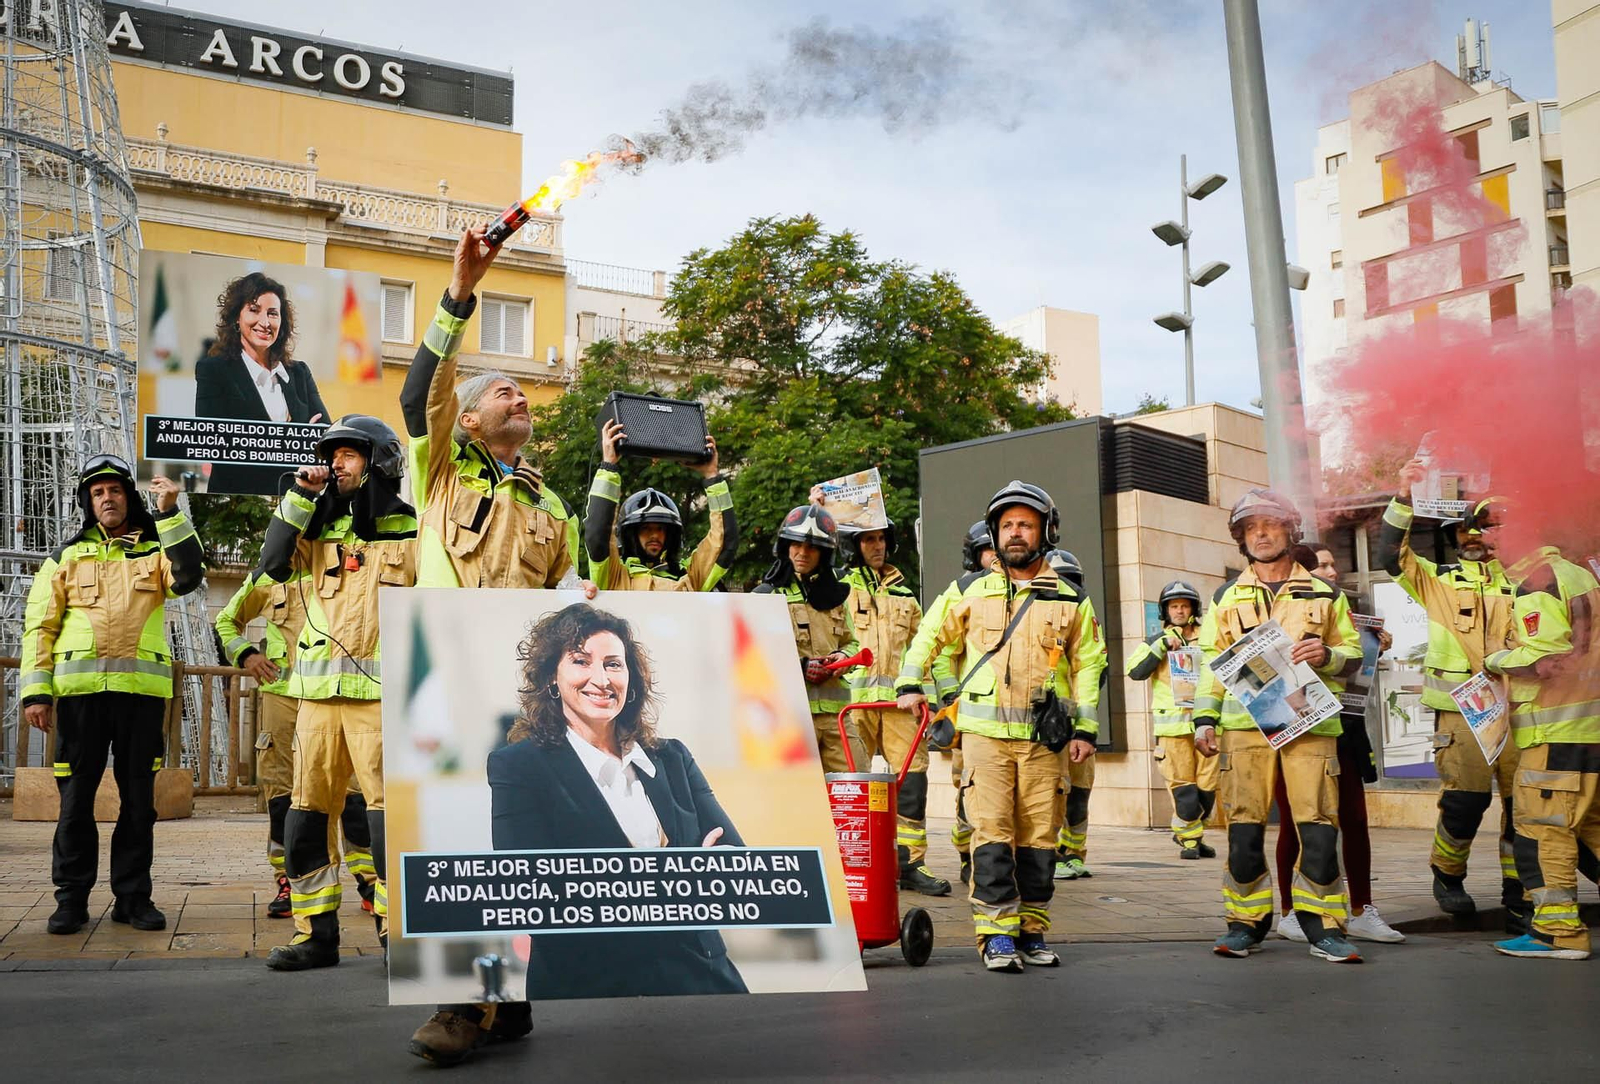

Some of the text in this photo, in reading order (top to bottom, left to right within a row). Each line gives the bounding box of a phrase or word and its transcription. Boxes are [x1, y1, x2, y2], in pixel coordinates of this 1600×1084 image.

[201, 29, 406, 98] ARCOS
[156, 433, 230, 448] ANDALUCÍA,
[232, 437, 282, 449] PORQUE
[284, 439, 301, 450] YO
[173, 420, 215, 433] MEJOR
[217, 423, 266, 436] SUELDO
[268, 426, 285, 436] DE
[286, 427, 327, 439] ALCAL
[186, 447, 220, 459] PERO
[222, 449, 247, 460] LOS
[249, 451, 316, 464] BOMBEROS
[824, 489, 844, 497] ATERIAL
[1271, 700, 1336, 745] DIGNIDAD BOMBEROS
[428, 851, 800, 878] 3º MEJOR SUELDO DE ALCALDÍA EN
[425, 878, 809, 903] ANDALUCÍA, PORQUE YO LO VALGO,
[482, 902, 760, 926] PERO LOS BOMBEROS NO
